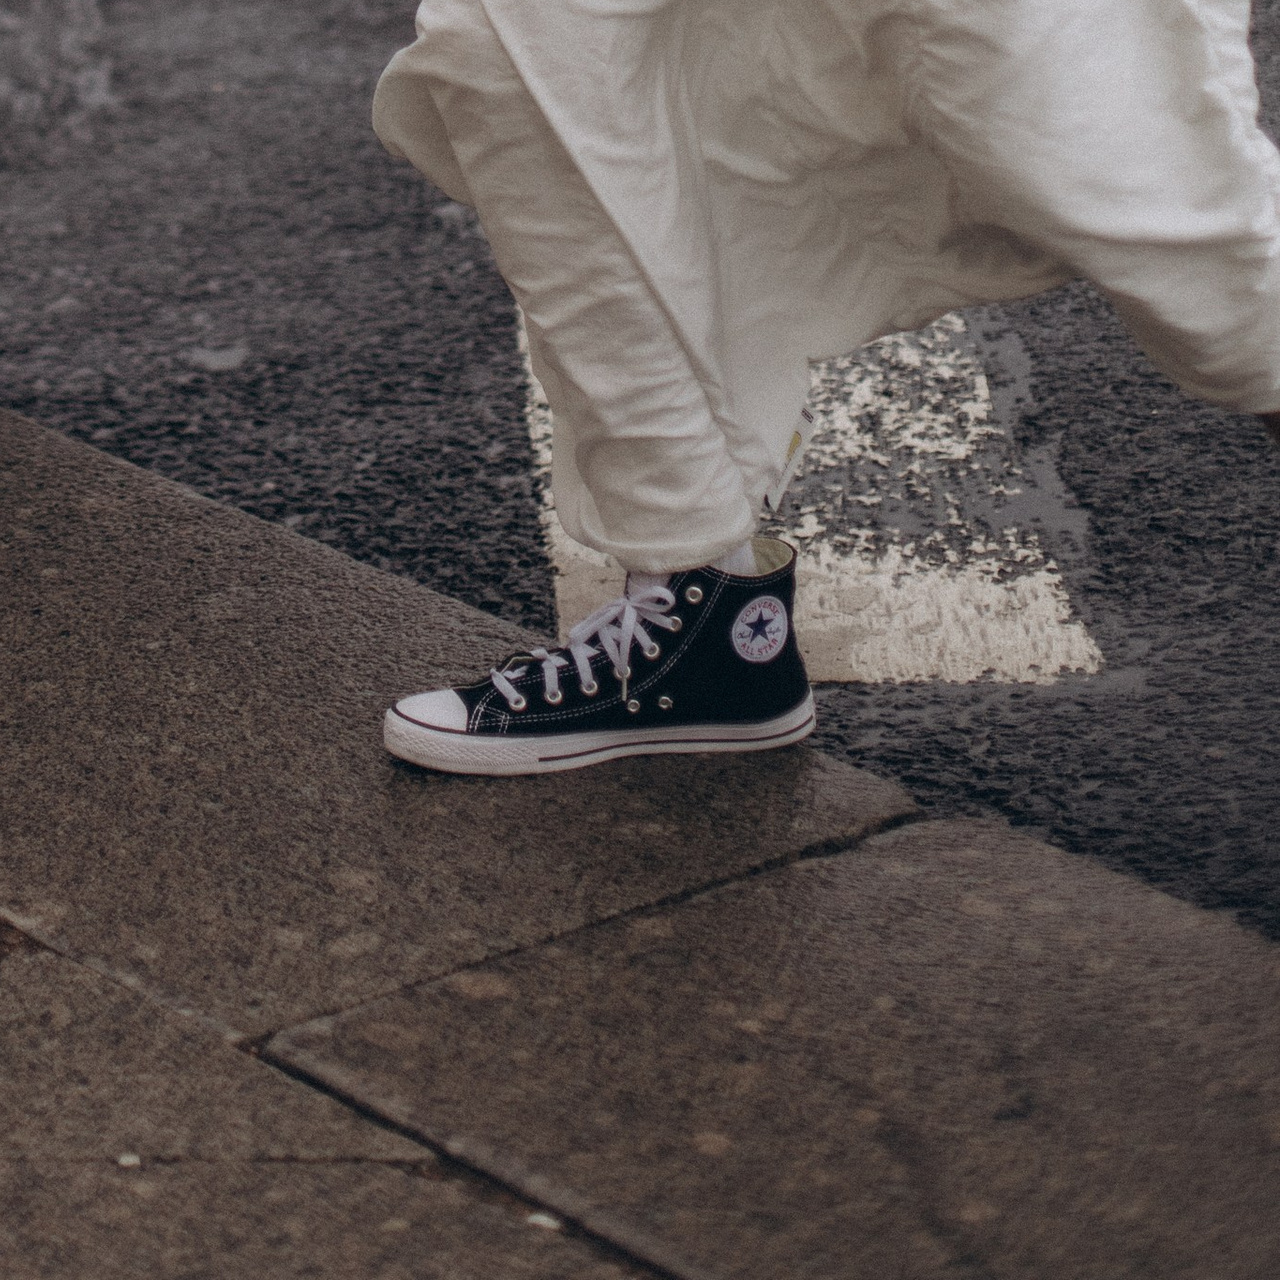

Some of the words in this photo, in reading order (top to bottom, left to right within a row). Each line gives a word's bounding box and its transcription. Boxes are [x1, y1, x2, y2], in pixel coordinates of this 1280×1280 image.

[740, 601, 780, 623] CONVERSE
[740, 642, 754, 656] ALL
[757, 638, 779, 656] STAR
